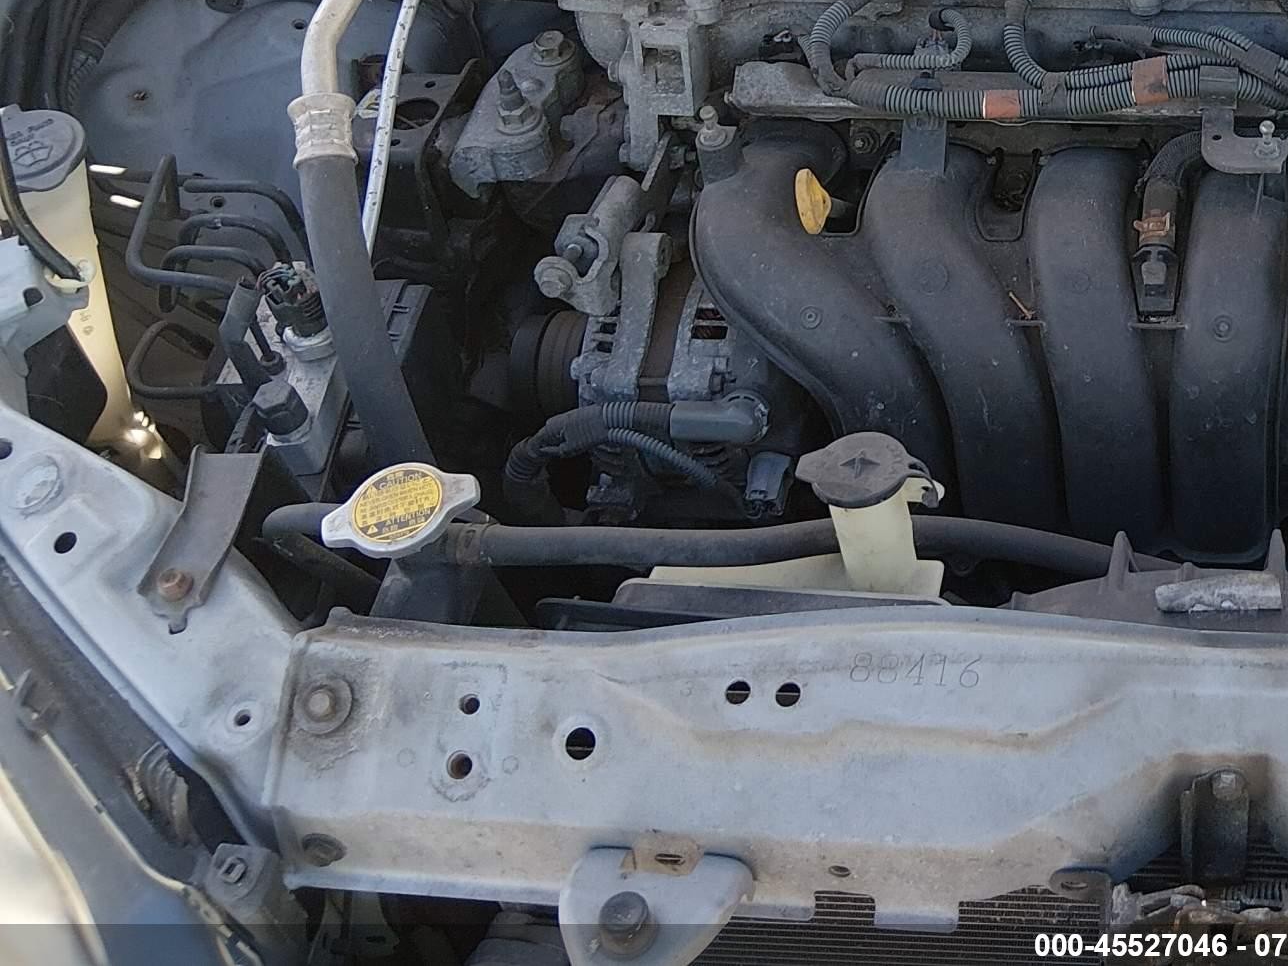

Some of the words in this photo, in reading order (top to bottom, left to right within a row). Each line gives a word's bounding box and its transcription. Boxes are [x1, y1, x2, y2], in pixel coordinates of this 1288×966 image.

[379, 472, 422, 490] CAUTION
[385, 507, 431, 525] ATTENTION
[849, 651, 983, 689] 88416
